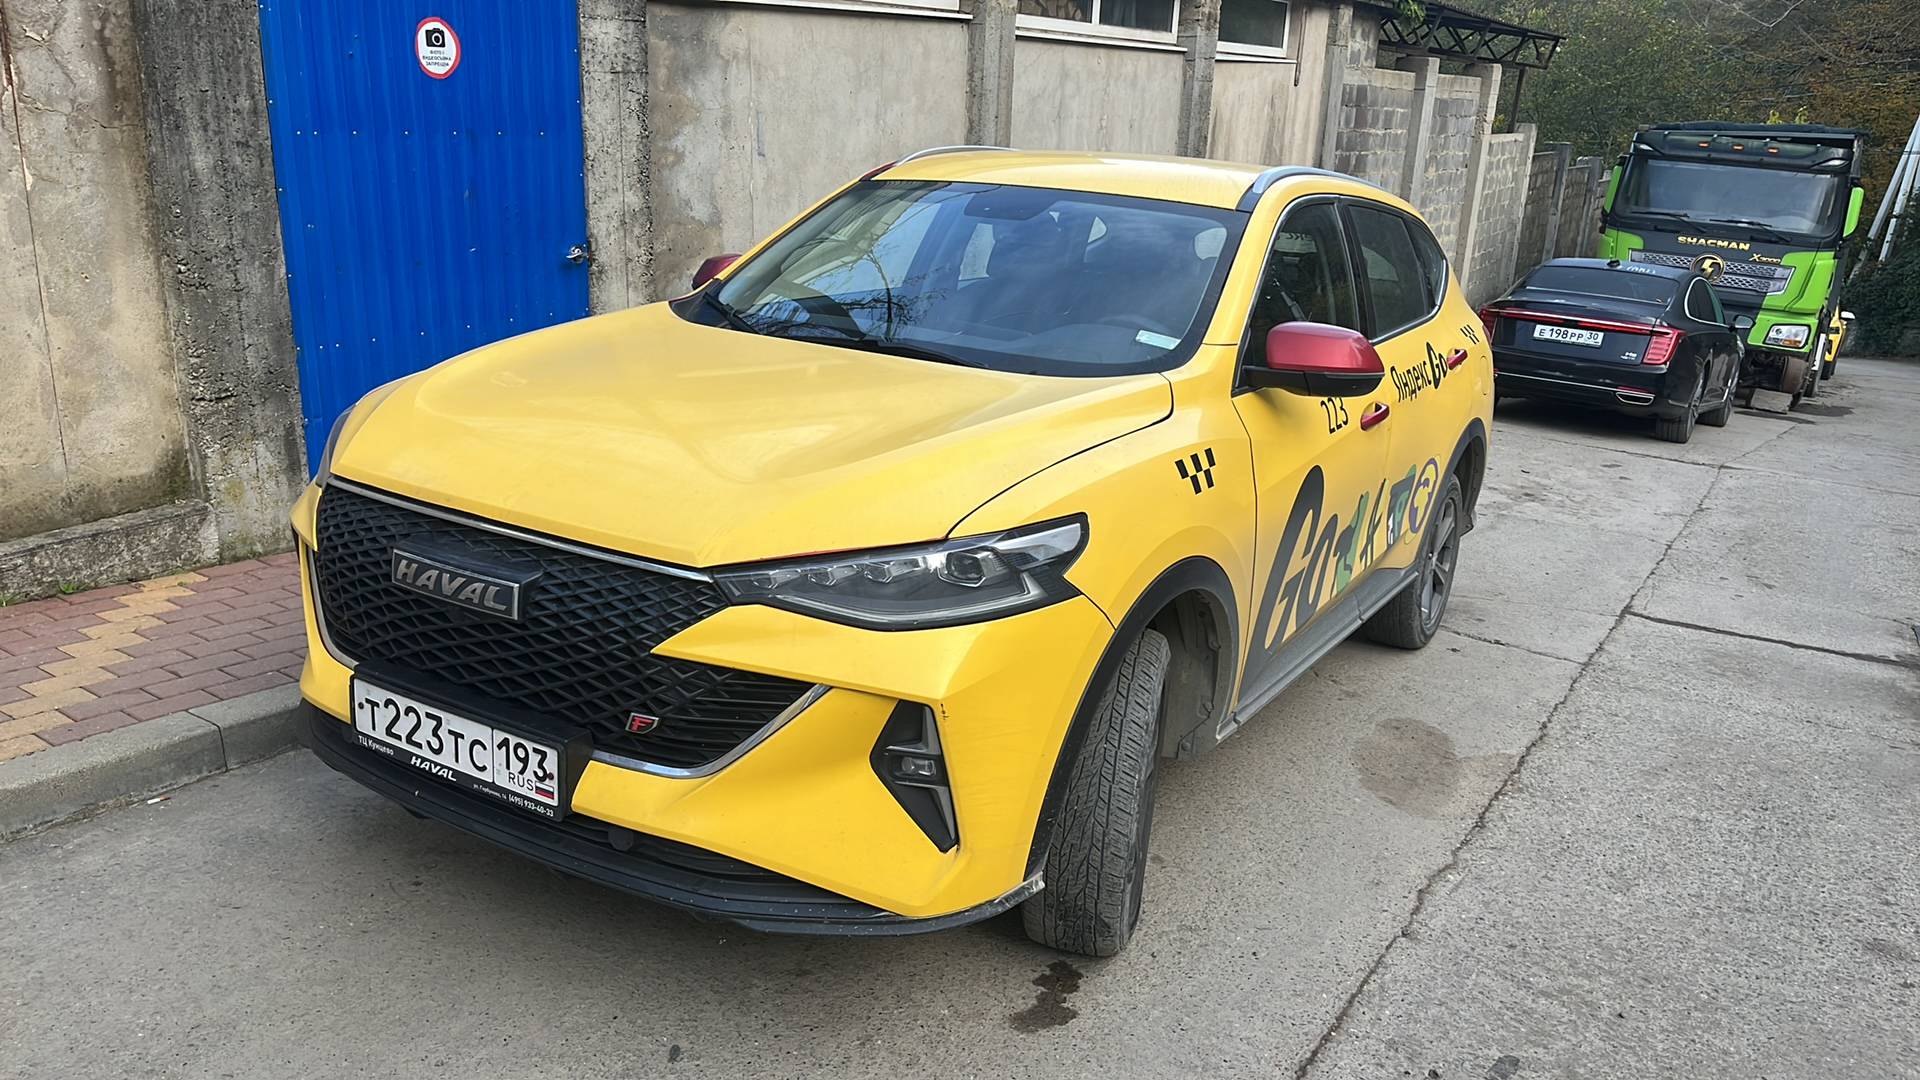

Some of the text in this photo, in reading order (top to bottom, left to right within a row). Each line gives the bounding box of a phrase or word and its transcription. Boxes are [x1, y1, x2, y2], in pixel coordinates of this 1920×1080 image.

[1677, 236, 1750, 251] SHACMAN
[1587, 331, 1599, 341] 30
[1390, 342, 1447, 402] Яндекс Go
[1320, 397, 1349, 434] 223
[396, 559, 508, 611] HAVAL
[358, 735, 367, 747] ТЦ
[410, 756, 457, 782] HAVAL
[497, 737, 548, 782] 193
[508, 772, 535, 791] RUS
